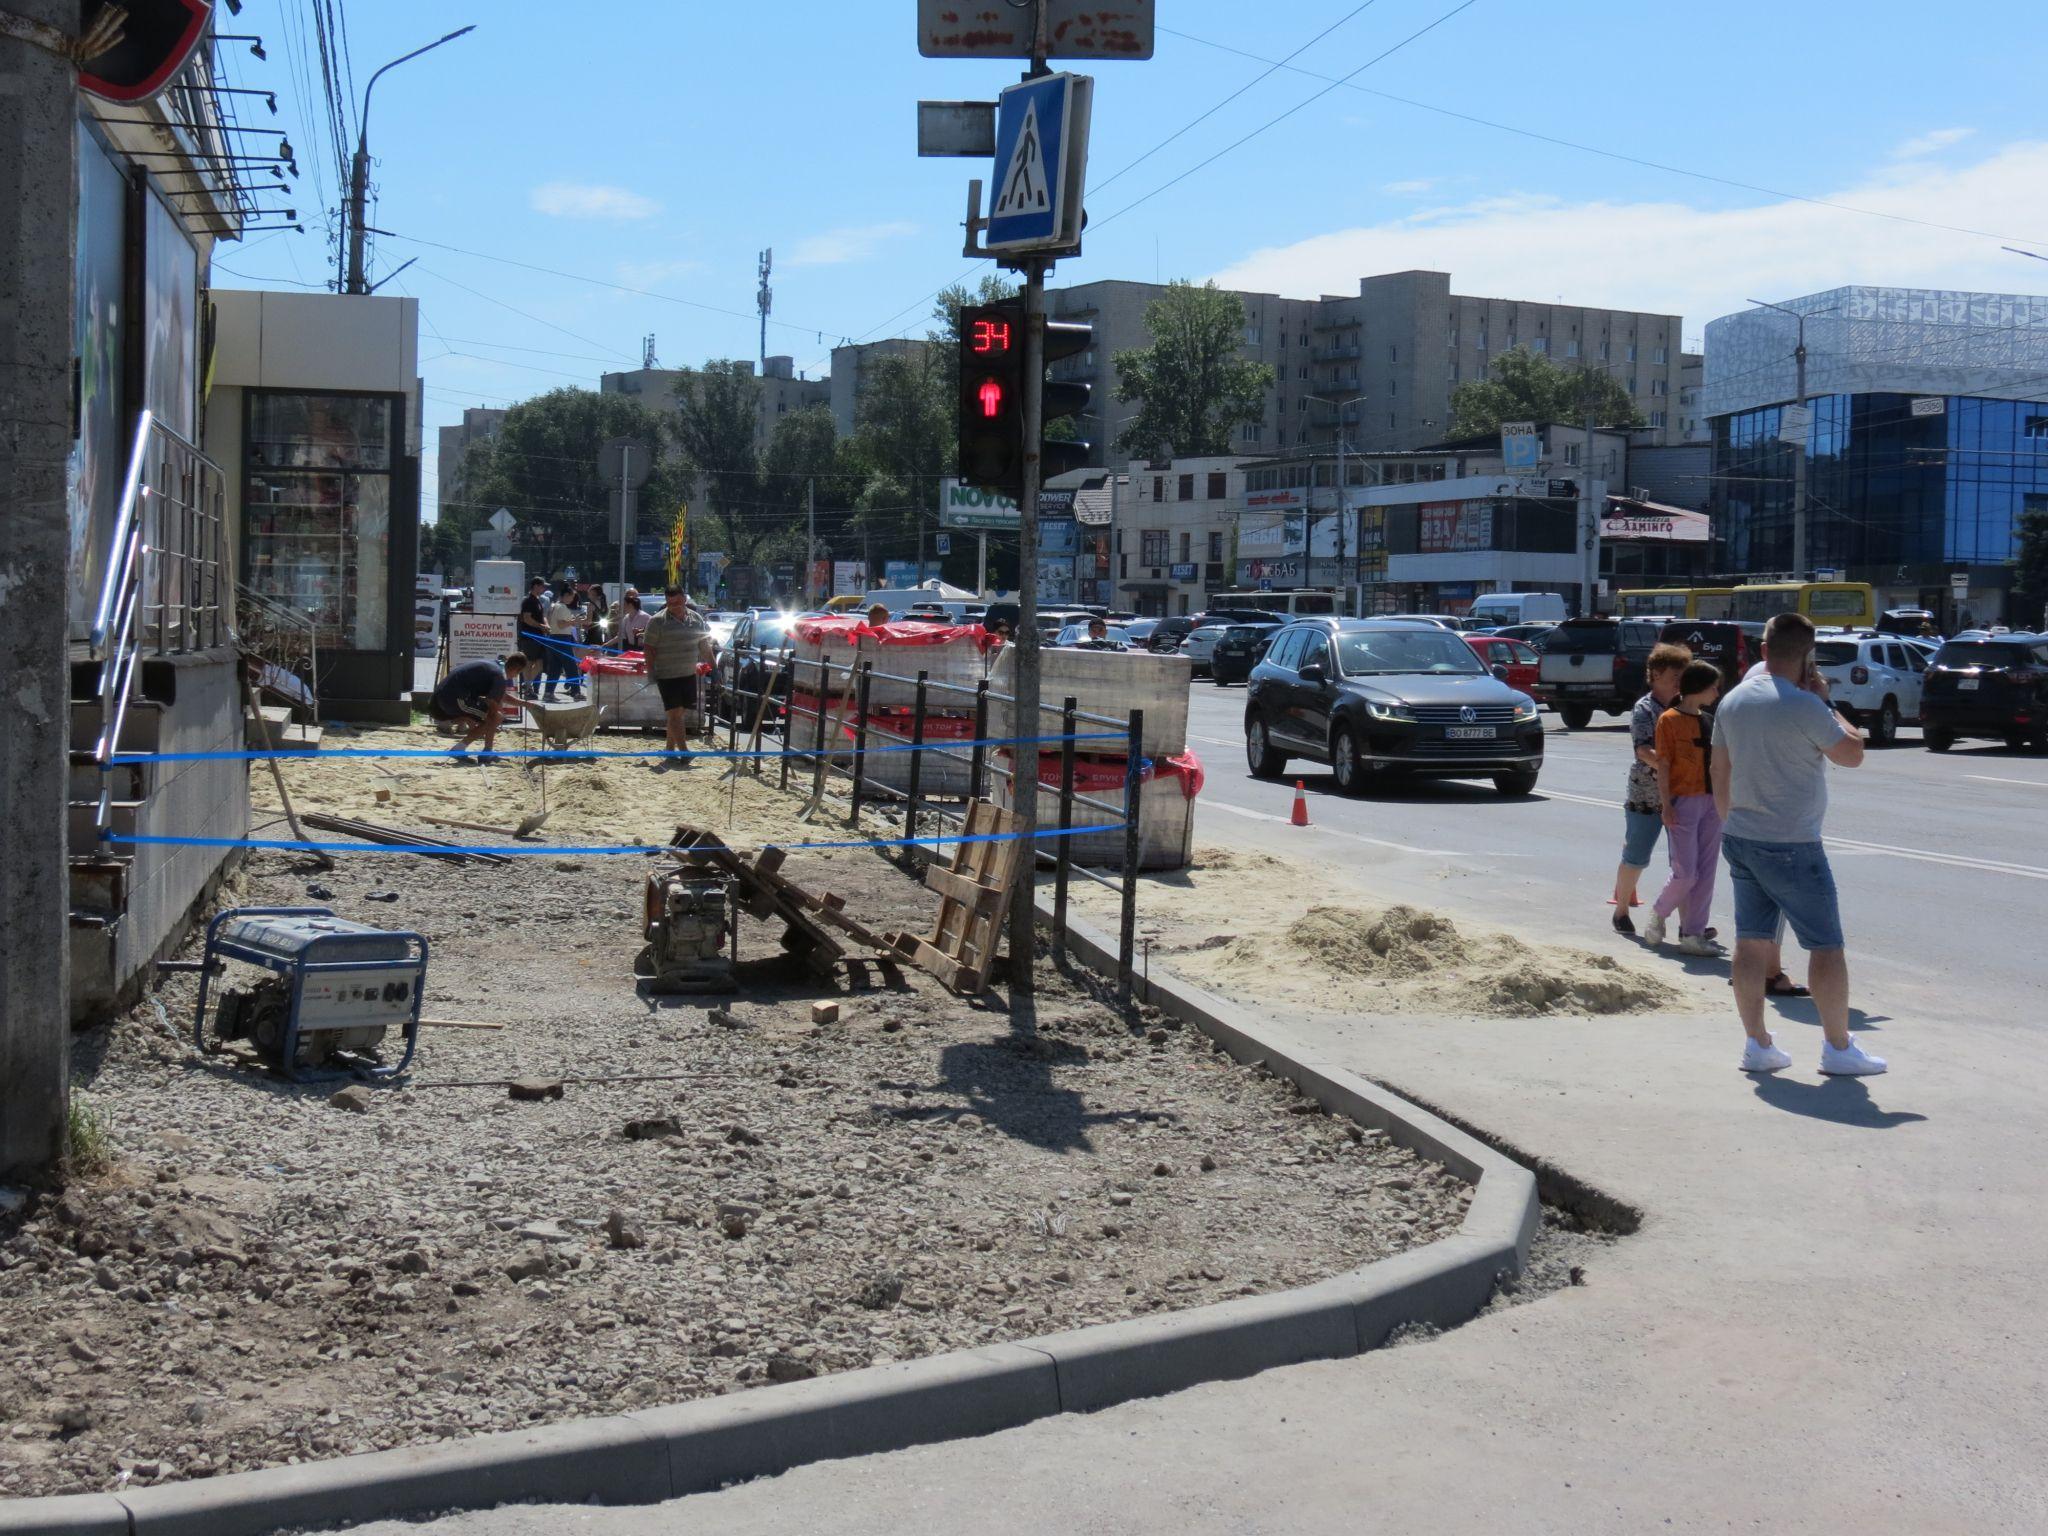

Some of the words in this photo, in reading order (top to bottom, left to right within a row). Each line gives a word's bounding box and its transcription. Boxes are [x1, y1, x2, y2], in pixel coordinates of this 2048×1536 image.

[974, 321, 1009, 351] 34
[1503, 426, 1534, 436] ЗОНА
[464, 623, 503, 631] ПОСЛУГИ
[454, 630, 514, 638] ВАНТАЖНИКІВ
